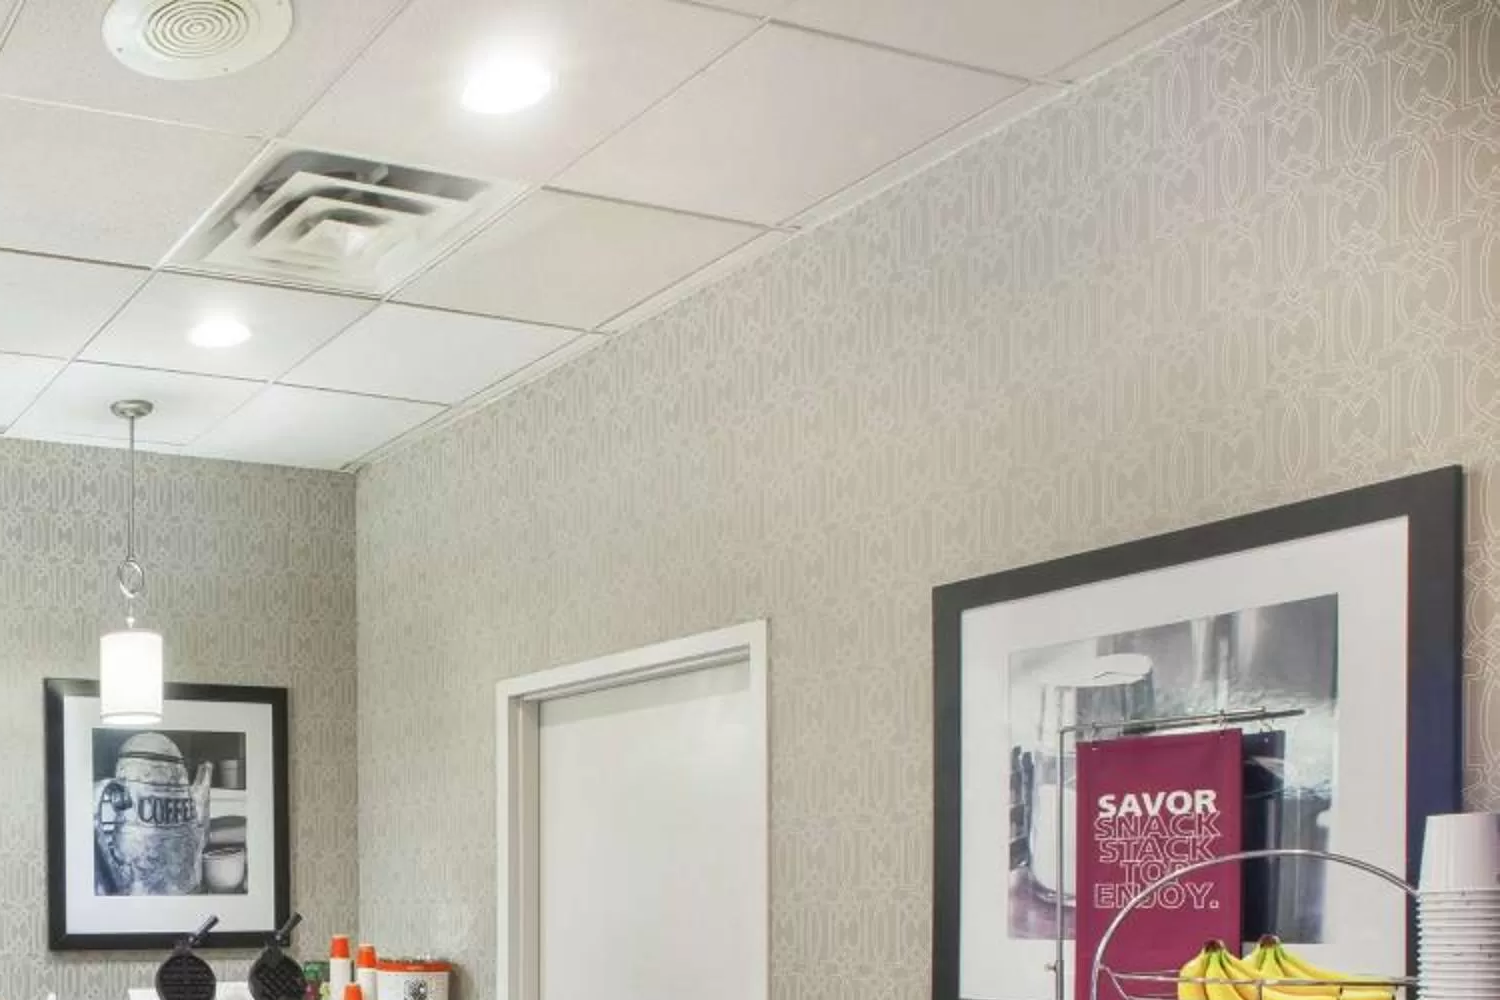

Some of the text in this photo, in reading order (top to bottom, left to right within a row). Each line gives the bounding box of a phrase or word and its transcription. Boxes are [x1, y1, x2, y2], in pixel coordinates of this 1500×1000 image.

[137, 796, 197, 824] COFFEE
[1097, 789, 1218, 818] SAVOR
[1094, 811, 1221, 840] SNACK
[1099, 837, 1216, 862] STACK
[1094, 882, 1220, 909] ENJOY.
